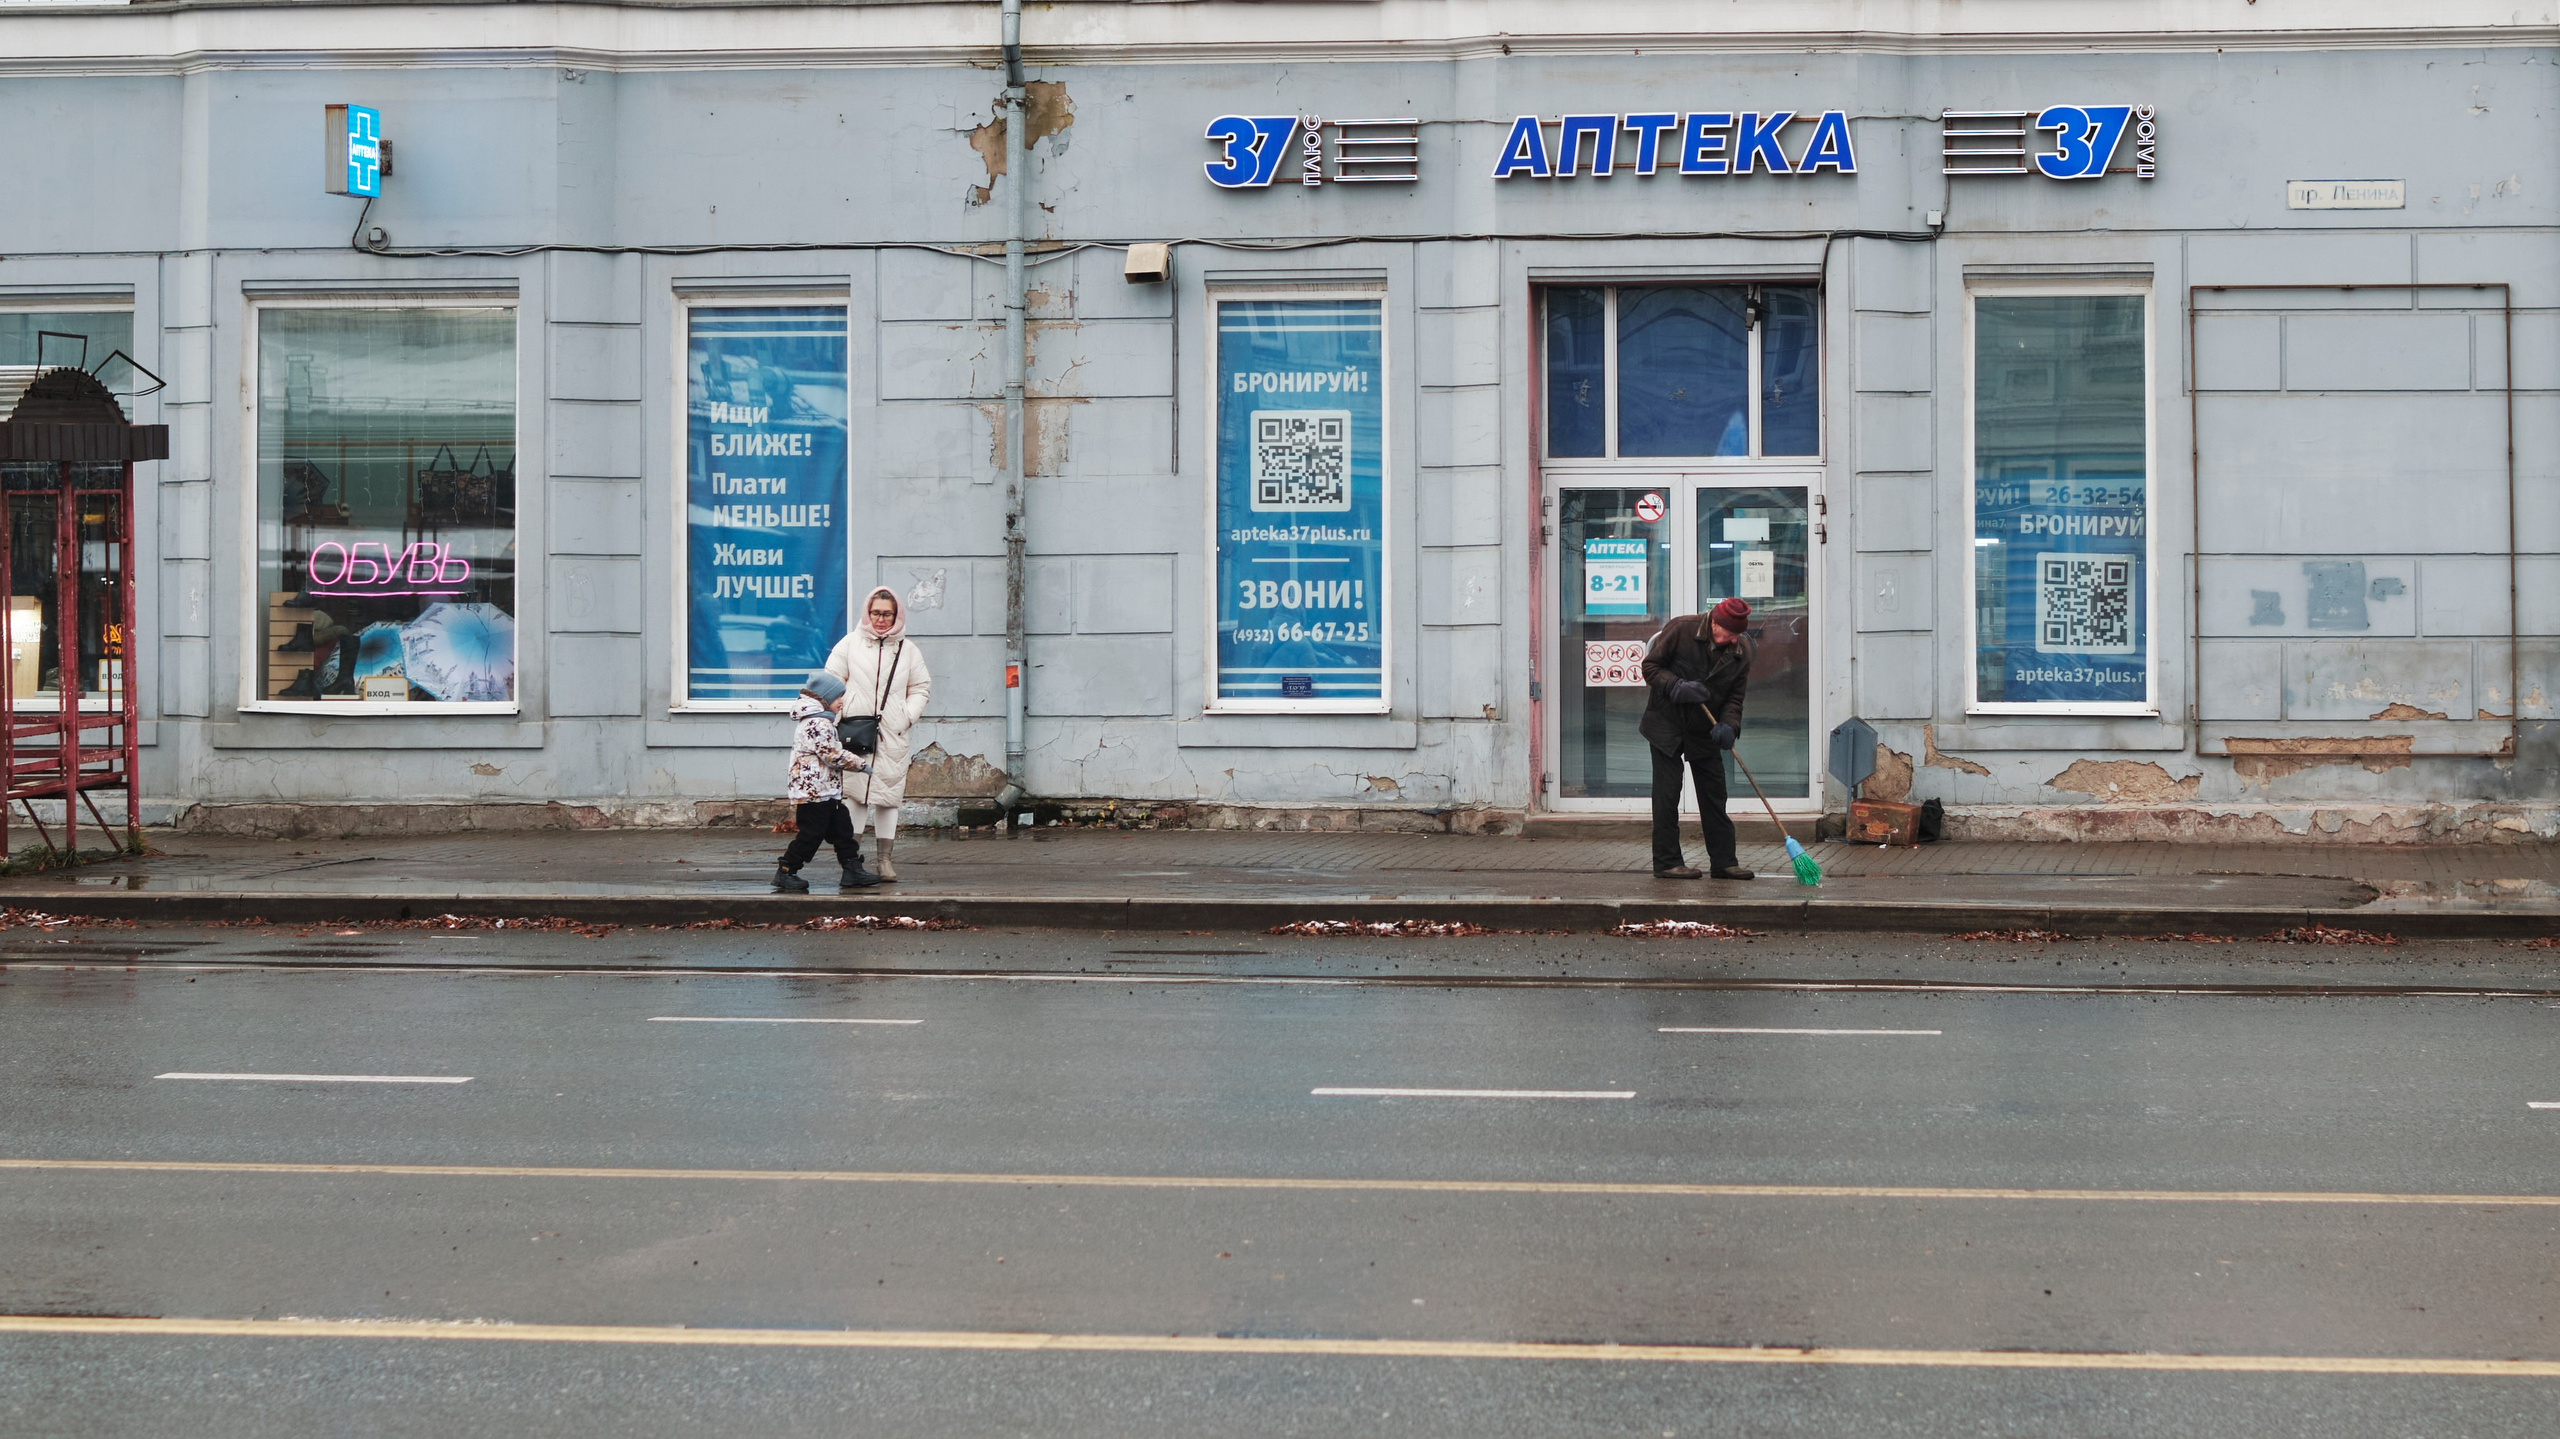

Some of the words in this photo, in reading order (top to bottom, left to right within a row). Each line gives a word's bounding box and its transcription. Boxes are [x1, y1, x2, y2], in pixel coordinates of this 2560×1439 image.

[351, 143, 376, 160] АПТЕКА
[1204, 115, 1299, 188] 37
[1303, 114, 1321, 186] ПЛЮС
[1491, 111, 1858, 179] АПТЕКА
[2035, 104, 2133, 180] 37
[2136, 103, 2155, 178] ПЛЮС
[1233, 365, 1368, 393] БРОНИРУЙ!
[710, 401, 768, 428] Ищи
[711, 433, 812, 457] БЛИЖЕ!
[712, 472, 786, 495] Плати
[2045, 485, 2144, 505] 26-32-54
[713, 504, 830, 528] МЕНЬШЕ!
[2020, 511, 2144, 536] БРОНИРУЙ
[1231, 525, 1371, 545] apteka37plus.ru
[713, 543, 783, 566] Живи
[1587, 543, 1645, 554] АПТЕКА
[309, 541, 470, 585] ОБУВЬ
[713, 574, 814, 599] ЛУЧШЕ!
[1238, 579, 1364, 610] ЗВОНИ!
[1590, 574, 1640, 591] 8-21
[1232, 629, 1274, 644] (4932)
[1277, 622, 1369, 643] 66-67-25
[366, 691, 391, 699] ВХОД
